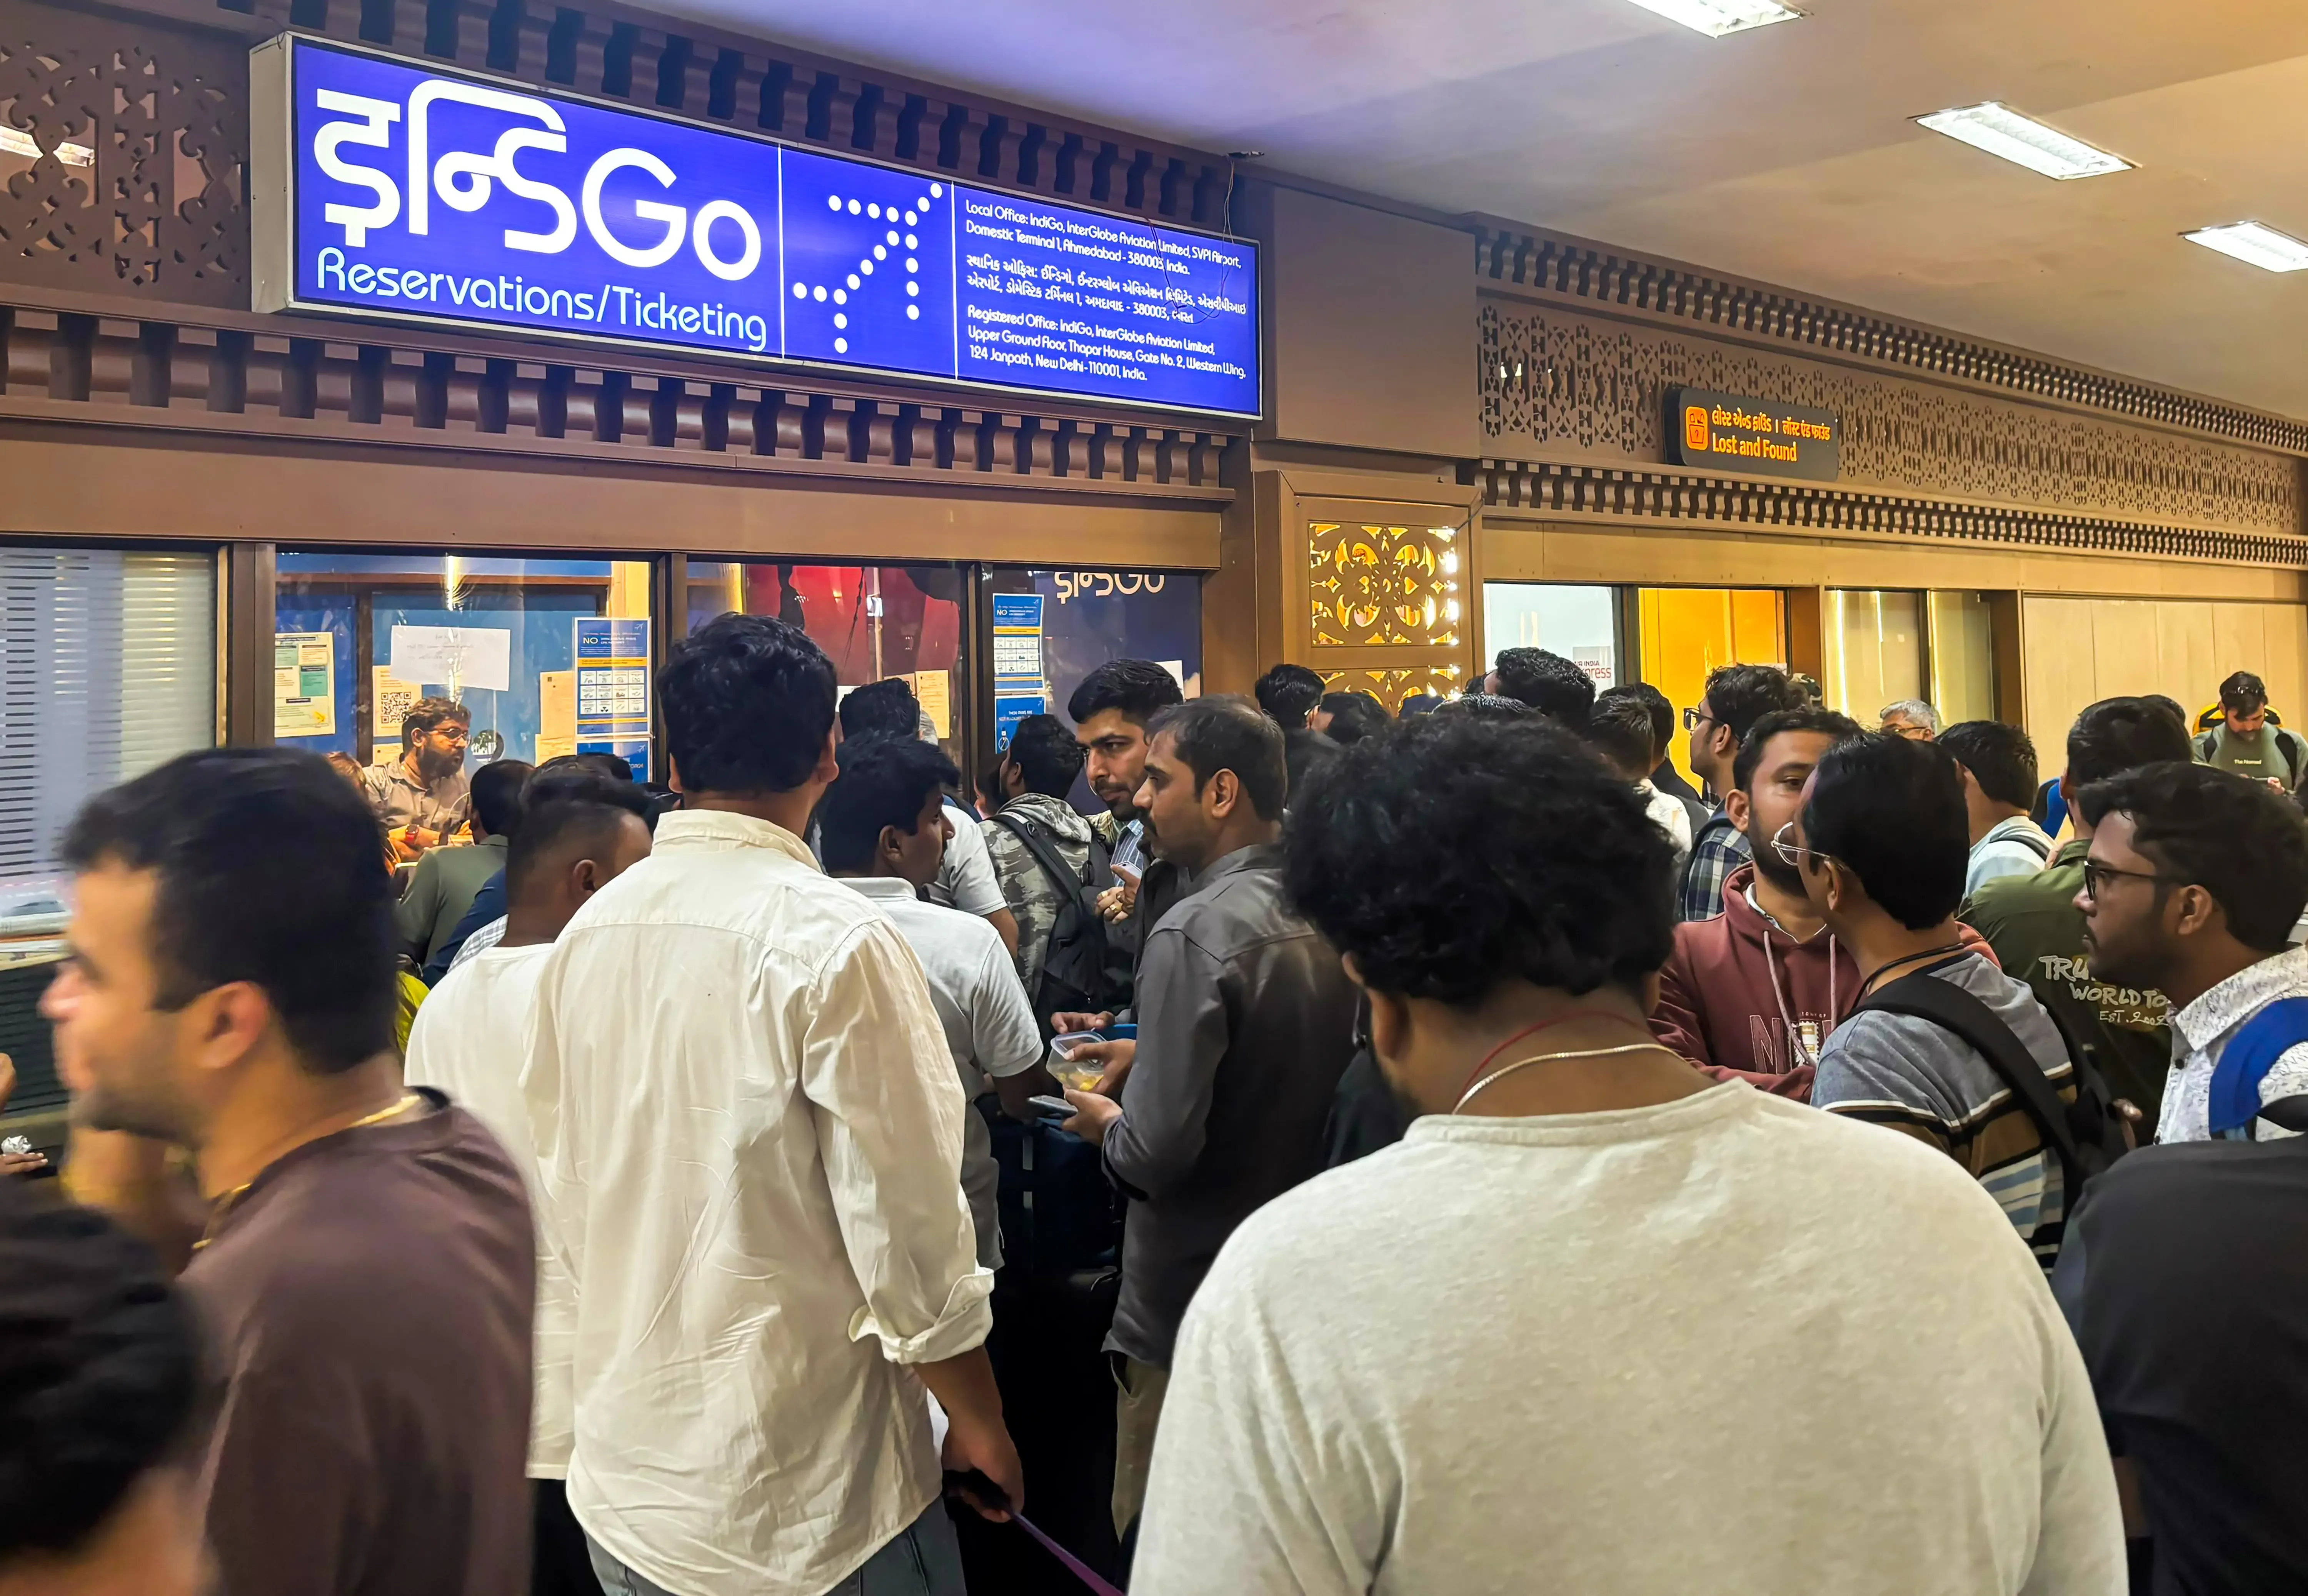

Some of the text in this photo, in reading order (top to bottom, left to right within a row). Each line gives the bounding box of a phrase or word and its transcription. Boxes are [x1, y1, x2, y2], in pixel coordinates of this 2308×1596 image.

[966, 199, 1241, 269] Local Office: IndiGo, InterGlobe Aviation Limited, SVPI Airport,
[966, 220, 1014, 241] Domestic
[1015, 229, 1055, 249] Terminal
[1167, 259, 1190, 275] India.
[317, 247, 767, 352] Reservations/Ticketing
[1133, 302, 1170, 321] 380003,
[967, 304, 1215, 355] Registered Office: IndiGo, InterGlobe Aviation Limited,
[968, 325, 1246, 380] Upper Ground Floor, Thapar House, Gate No. 2, Western Wing,
[970, 345, 988, 360] 124
[990, 347, 1034, 367] Janpath,
[1036, 354, 1058, 369] New
[1123, 365, 1148, 380] India.
[1713, 433, 1797, 462] Lost and Found
[2069, 982, 2141, 1006] WORLD
